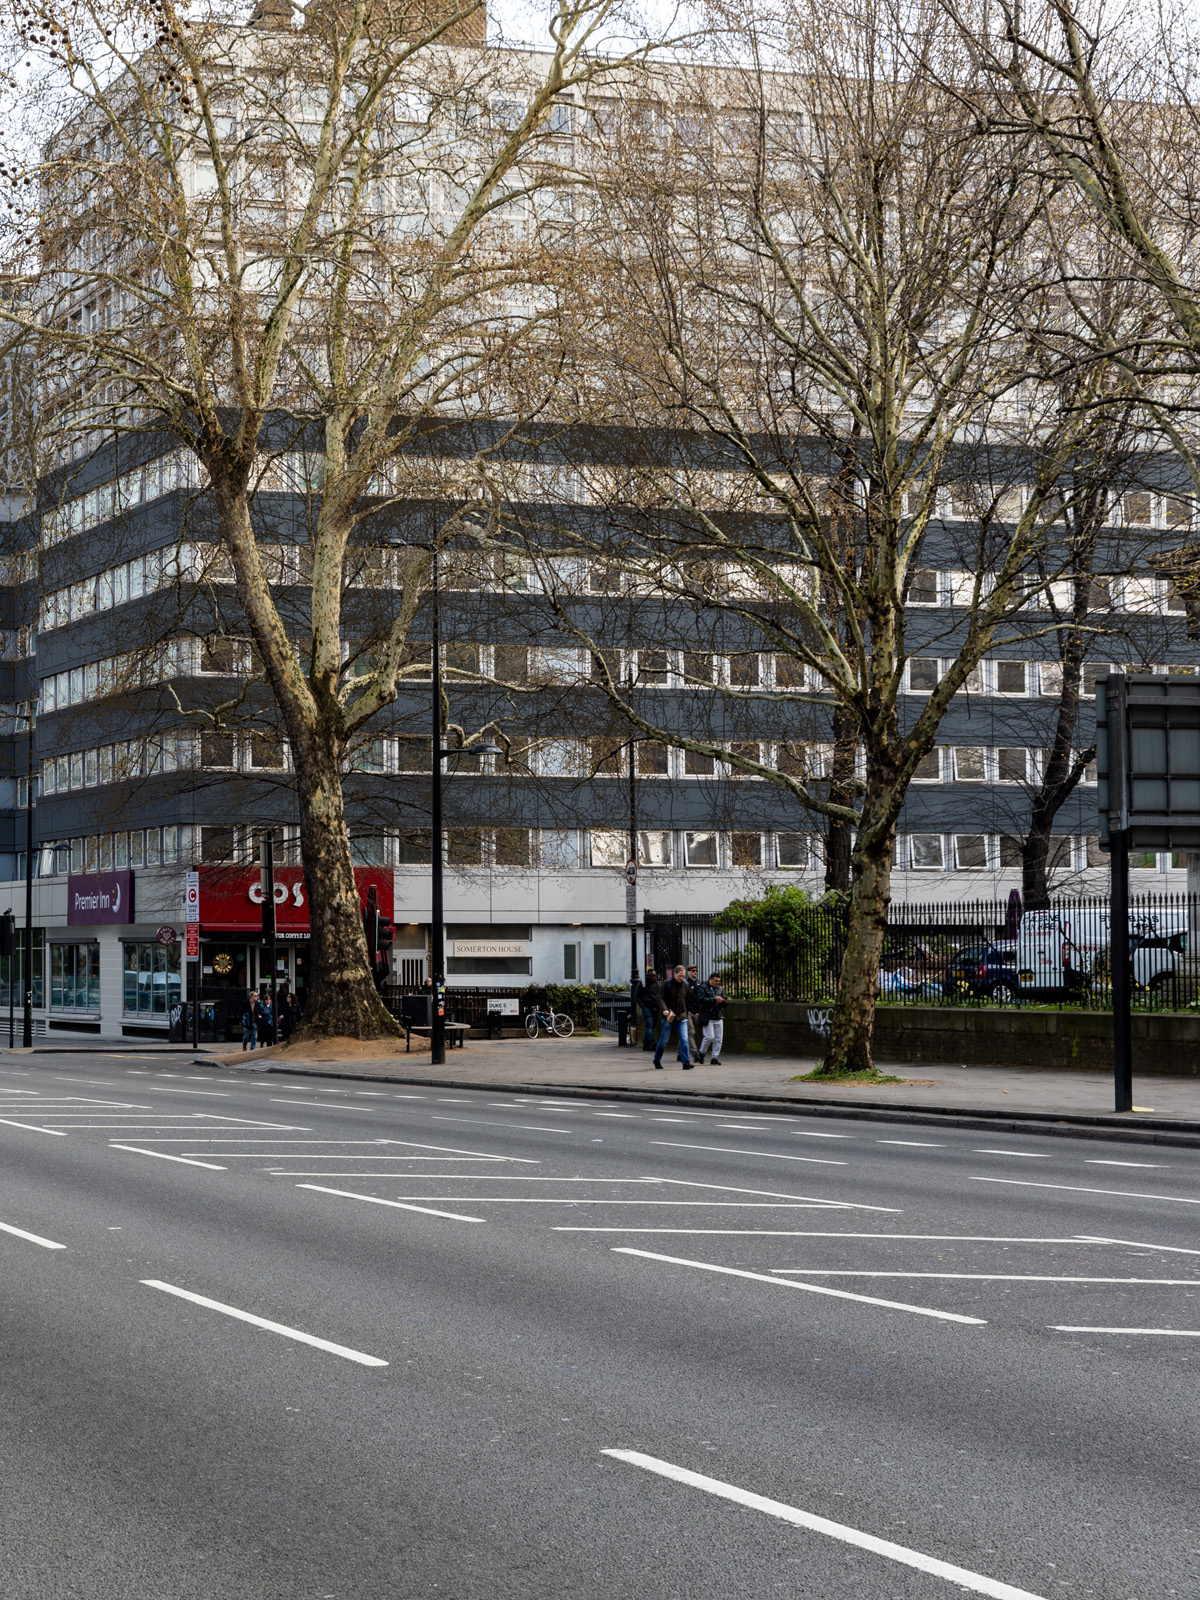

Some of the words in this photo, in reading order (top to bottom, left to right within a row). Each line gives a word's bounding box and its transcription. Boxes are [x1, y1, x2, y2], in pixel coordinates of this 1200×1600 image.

[75, 892, 99, 910] Premier
[100, 891, 110, 909] Inn
[456, 945, 497, 953] SOMERTON
[498, 945, 523, 953] HOUSE
